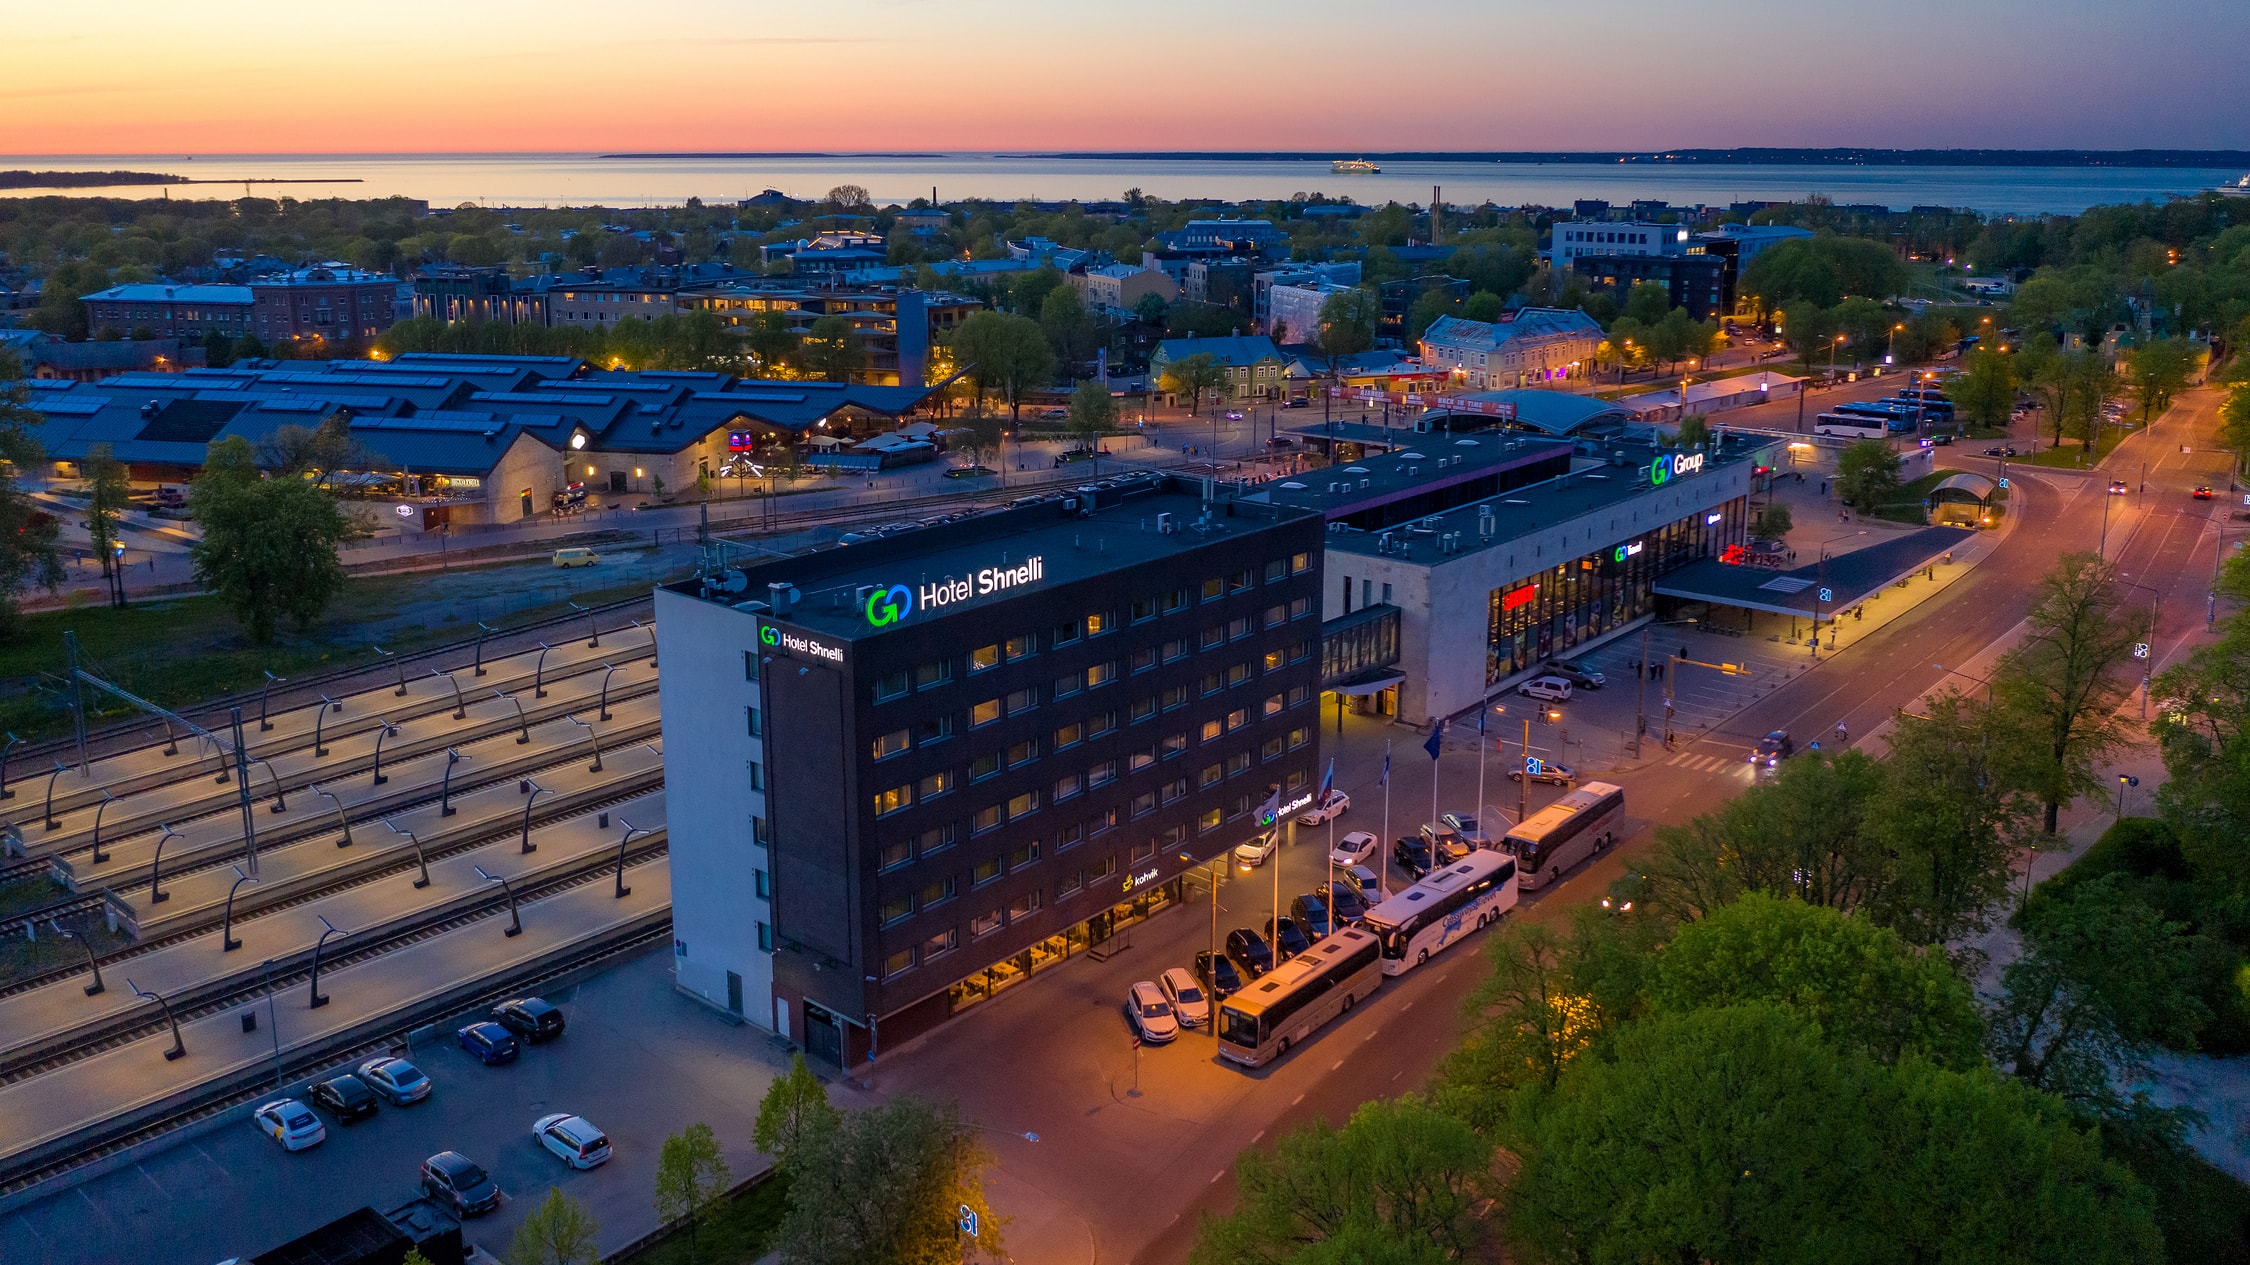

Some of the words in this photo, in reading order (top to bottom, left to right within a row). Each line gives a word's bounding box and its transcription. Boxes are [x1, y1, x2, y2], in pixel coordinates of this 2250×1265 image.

[1674, 453, 1704, 474] Group
[920, 573, 973, 611] Hotel
[978, 556, 1043, 595] Shnelli
[783, 633, 808, 653] Hotel
[809, 641, 844, 662] Shnelli
[1134, 867, 1159, 887] kohvik
